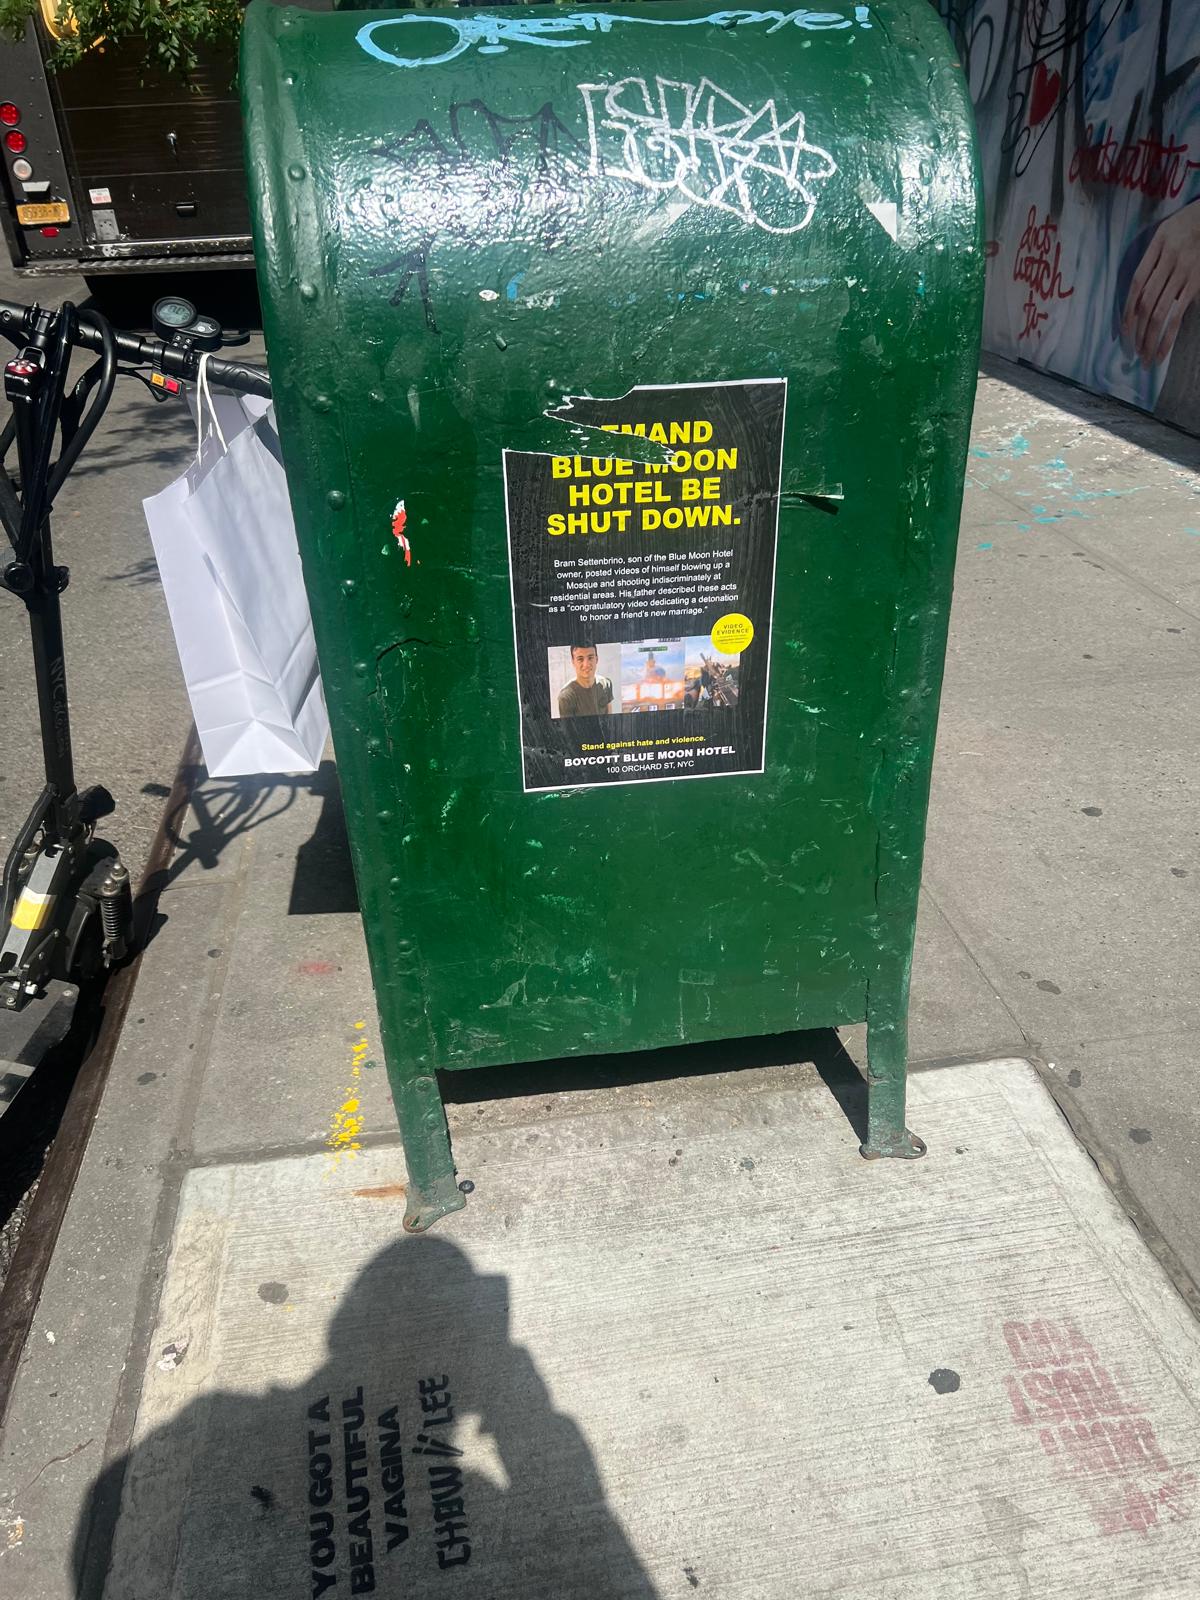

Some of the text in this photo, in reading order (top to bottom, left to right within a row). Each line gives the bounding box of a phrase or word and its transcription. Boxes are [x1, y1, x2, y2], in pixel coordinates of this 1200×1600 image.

[551, 455, 634, 479] BLUE
[569, 477, 721, 507] HOTEL BE
[547, 505, 741, 536] SHUT DOWN.
[554, 549, 734, 568] Bram Settenbrino, son of the Blue Moon Hotel
[556, 571, 583, 579] owner,
[585, 568, 612, 578] posted
[614, 567, 640, 576] videos
[641, 565, 650, 574] of
[651, 563, 680, 573] himself
[681, 562, 711, 571] blowing
[713, 561, 723, 571] up
[566, 572, 722, 590] Mosque and shooting indiscriminately at
[550, 583, 737, 602] residential areas. His father described these acts
[627, 599, 649, 608] video
[650, 596, 690, 606] dedicating
[691, 596, 697, 604] a
[698, 593, 739, 603] detonation
[580, 613, 588, 622] to
[589, 613, 612, 621] honor
[621, 610, 649, 619] friend's
[651, 609, 667, 617] new
[581, 735, 706, 751] Stand against hate and violence.
[564, 745, 735, 767] BOYCOTT BLUE MOON HOTEL
[606, 766, 620, 774] 100
[621, 763, 662, 773] ORCHARD
[677, 760, 695, 768] NYC
[418, 1374, 453, 1428] LEE
[377, 1405, 409, 1553] VAGINA
[307, 1395, 337, 1600] YOU GOT A
[342, 1386, 375, 1595] BEAUTIFUL
